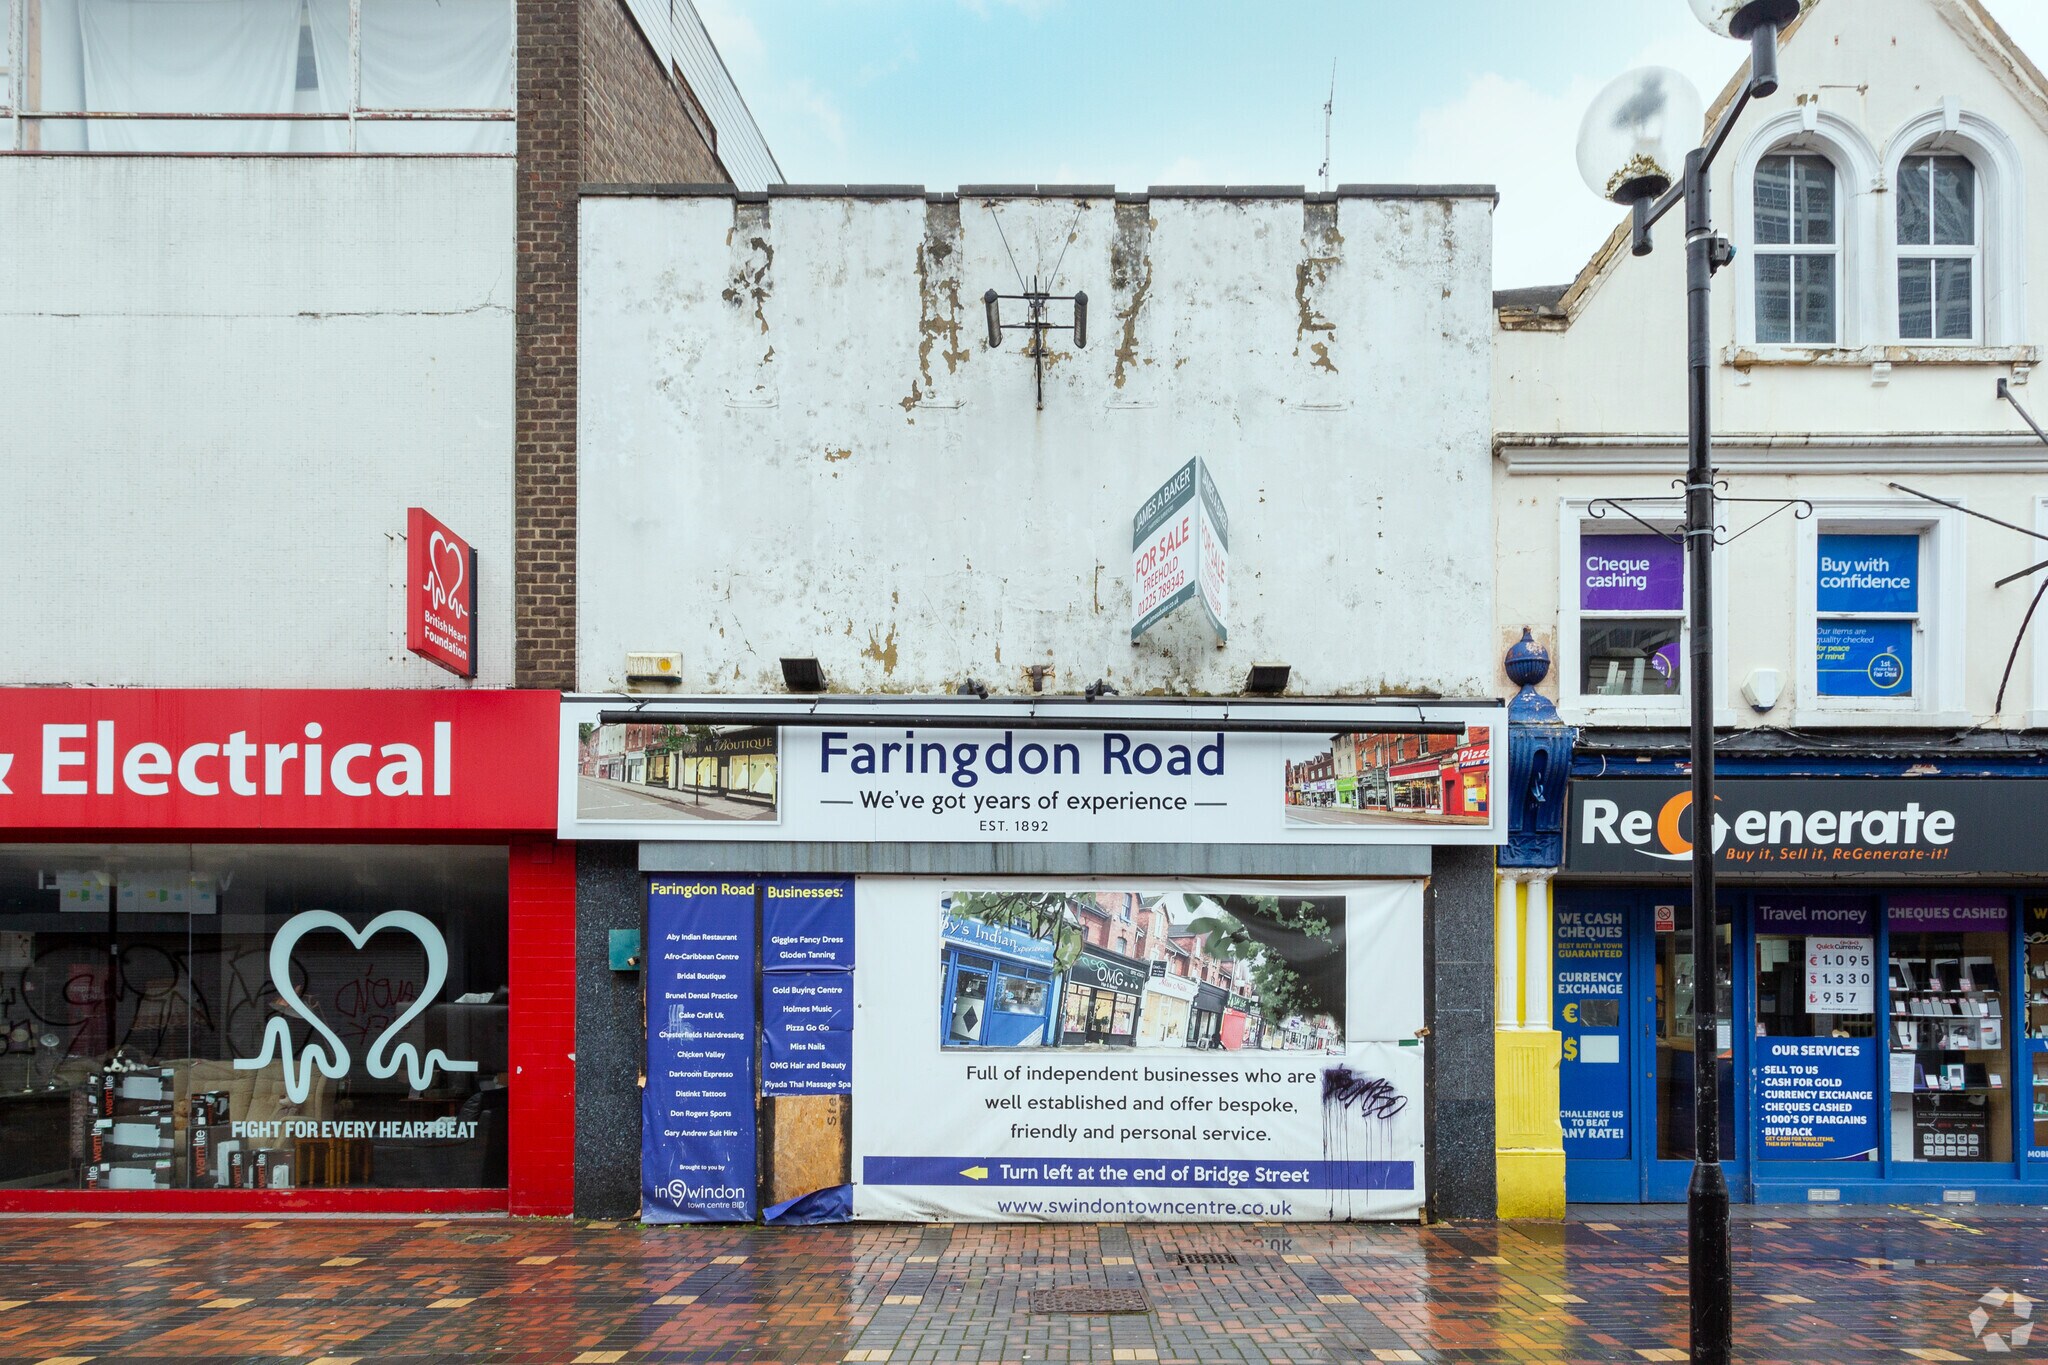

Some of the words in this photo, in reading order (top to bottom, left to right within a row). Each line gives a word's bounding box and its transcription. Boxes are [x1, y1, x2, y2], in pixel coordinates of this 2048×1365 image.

[1136, 498, 1157, 532] JAMES
[1157, 492, 1164, 507] A
[1164, 467, 1191, 501] BAKER
[1136, 546, 1157, 583] FOR
[1160, 517, 1189, 561] SALE
[1586, 557, 1650, 575] Cheque
[1822, 557, 1851, 575] Buy
[1853, 558, 1889, 572] with
[1143, 556, 1179, 594] FREEHOLD
[1586, 574, 1648, 590] cashing
[1821, 574, 1910, 589] confidence
[1138, 590, 1157, 617] 01225
[1158, 570, 1185, 601] 789343
[424, 610, 447, 633] British
[448, 624, 467, 644] Heart
[424, 626, 467, 660] Foundation
[1817, 636, 1841, 645] quality
[1843, 636, 1874, 644] checked
[42, 720, 451, 796] Electrical
[822, 731, 1079, 787] Faringdon
[1104, 731, 1226, 775] Road
[860, 790, 924, 808] We've
[932, 793, 965, 814] got
[974, 796, 1030, 813] years
[1038, 791, 1059, 809] of
[1067, 791, 1187, 814] experience
[980, 821, 1008, 831] EST.
[1015, 821, 1048, 831] 1892
[1726, 848, 1753, 862] Buy
[1759, 848, 1774, 860] it,
[1780, 848, 1807, 859] Sell
[1812, 848, 1826, 861] it,
[1833, 848, 1948, 860] ReGenerate-it!
[651, 882, 717, 898] Faringdon
[722, 882, 755, 896] Road
[768, 886, 843, 898] Businesses:
[1558, 913, 1582, 925] WE
[1585, 913, 1622, 925] CASH
[1760, 907, 1807, 920] Travel
[1812, 910, 1867, 924] money
[1888, 907, 1949, 921] CHEQUES
[1953, 907, 2008, 919] CASHED
[667, 933, 680, 941] Aby
[682, 933, 701, 941] Indian
[702, 933, 737, 941] Restaurant
[1558, 926, 1623, 941] CHEQUES
[772, 936, 798, 945] Giggles
[800, 935, 821, 944] Fancy
[823, 935, 843, 943] Dress
[664, 952, 714, 960] Afro-Caribbean
[716, 953, 739, 961] Centre
[780, 951, 806, 959] Gloden
[808, 951, 835, 960] Tanning
[1558, 950, 1623, 958] GUARANTEED
[677, 972, 695, 980] Bridal
[697, 972, 726, 981] Boutique
[1558, 972, 1623, 983] CURRENCY
[773, 986, 790, 994] Gold
[792, 986, 815, 995] Buying
[817, 986, 842, 994] Centre
[1558, 984, 1623, 994] EXCHANGE
[666, 991, 687, 999] Brunel
[688, 992, 709, 1000] Dental
[711, 992, 738, 1000] Practice
[783, 1005, 810, 1013] Holmes
[812, 1004, 833, 1013] Music
[786, 1023, 804, 1031] Pizza
[806, 1023, 817, 1031] Go
[819, 1023, 830, 1031] Go
[790, 1042, 806, 1050] Miss
[808, 1042, 825, 1050] Nails
[1772, 1045, 1798, 1056] OUR
[1801, 1045, 1860, 1056] SERVICES
[677, 1050, 703, 1059] Chicken
[705, 1051, 725, 1059] Valley
[770, 1061, 788, 1069] OMG
[790, 1061, 805, 1069] Hair
[807, 1061, 819, 1069] and
[822, 1061, 846, 1070] Beauty
[1764, 1065, 1788, 1074] SELL
[1790, 1066, 1803, 1074] TO
[1805, 1066, 1819, 1075] US
[669, 1069, 702, 1077] Darkroom
[703, 1070, 733, 1078] Expresso
[967, 1066, 998, 1080] Full
[1004, 1066, 1021, 1080] of
[1028, 1066, 1138, 1084] independent
[1145, 1067, 1238, 1082] businesses
[1245, 1068, 1281, 1083] who
[1288, 1073, 1316, 1083] are
[764, 1080, 788, 1089] Piyada
[789, 1080, 804, 1088] Thai
[806, 1080, 836, 1089] Massage
[838, 1080, 851, 1089] Spa
[1765, 1078, 1791, 1086] CASH
[1793, 1078, 1812, 1087] FOR
[1814, 1079, 1842, 1087] GOLD
[676, 1090, 700, 1098] Distinkt
[702, 1090, 726, 1098] Tattoos
[1765, 1090, 1817, 1099] CURRENCY
[1819, 1091, 1873, 1100] EXCHANGE
[985, 1095, 1021, 1109] well
[1028, 1095, 1126, 1110] established
[1133, 1096, 1163, 1110] and
[1170, 1096, 1213, 1111] offer
[1219, 1097, 1297, 1115] bespoke,
[1765, 1102, 1810, 1113] CHEQUES
[1812, 1103, 1852, 1112] CASHED
[671, 1109, 684, 1117] Don
[686, 1109, 708, 1118] Rogers
[710, 1109, 732, 1118] Sports
[1560, 1110, 1610, 1118] CHALLENGE
[1612, 1110, 1624, 1118] US
[1571, 1119, 1584, 1127] TO
[1586, 1119, 1609, 1127] BEAT
[1765, 1115, 1799, 1124] 1000'S
[1801, 1115, 1815, 1124] OF
[1816, 1116, 1867, 1125] BARGAINS
[231, 1121, 282, 1138] FIGHT
[285, 1121, 318, 1138] FOR
[322, 1121, 377, 1138] EVERY
[379, 1121, 478, 1139] HEARTBEAT
[664, 1129, 680, 1137] Gary
[682, 1129, 707, 1137] Andrew
[709, 1129, 722, 1137] Suit
[724, 1129, 737, 1137] Hire
[1011, 1124, 1077, 1142] friendly
[1084, 1125, 1114, 1139] and
[1121, 1126, 1196, 1143] personal
[1203, 1126, 1270, 1140] service.
[1562, 1128, 1586, 1138] ANY
[1588, 1128, 1624, 1138] RATE!
[1765, 1127, 1812, 1136] BUYBACK
[193, 1129, 206, 1177] warmlite
[1000, 1165, 1038, 1179] Turn
[1044, 1164, 1072, 1179] left
[1078, 1166, 1094, 1180] at
[1099, 1165, 1128, 1180] the
[1134, 1166, 1165, 1180] end
[1171, 1166, 1189, 1180] of
[1195, 1166, 1249, 1183] Bridge
[1255, 1167, 1309, 1182] Street
[687, 1201, 703, 1209] town
[704, 1201, 730, 1209] centre
[731, 1201, 745, 1209] BID
[998, 1198, 1292, 1216] www.swindontowncentre.co.uk
